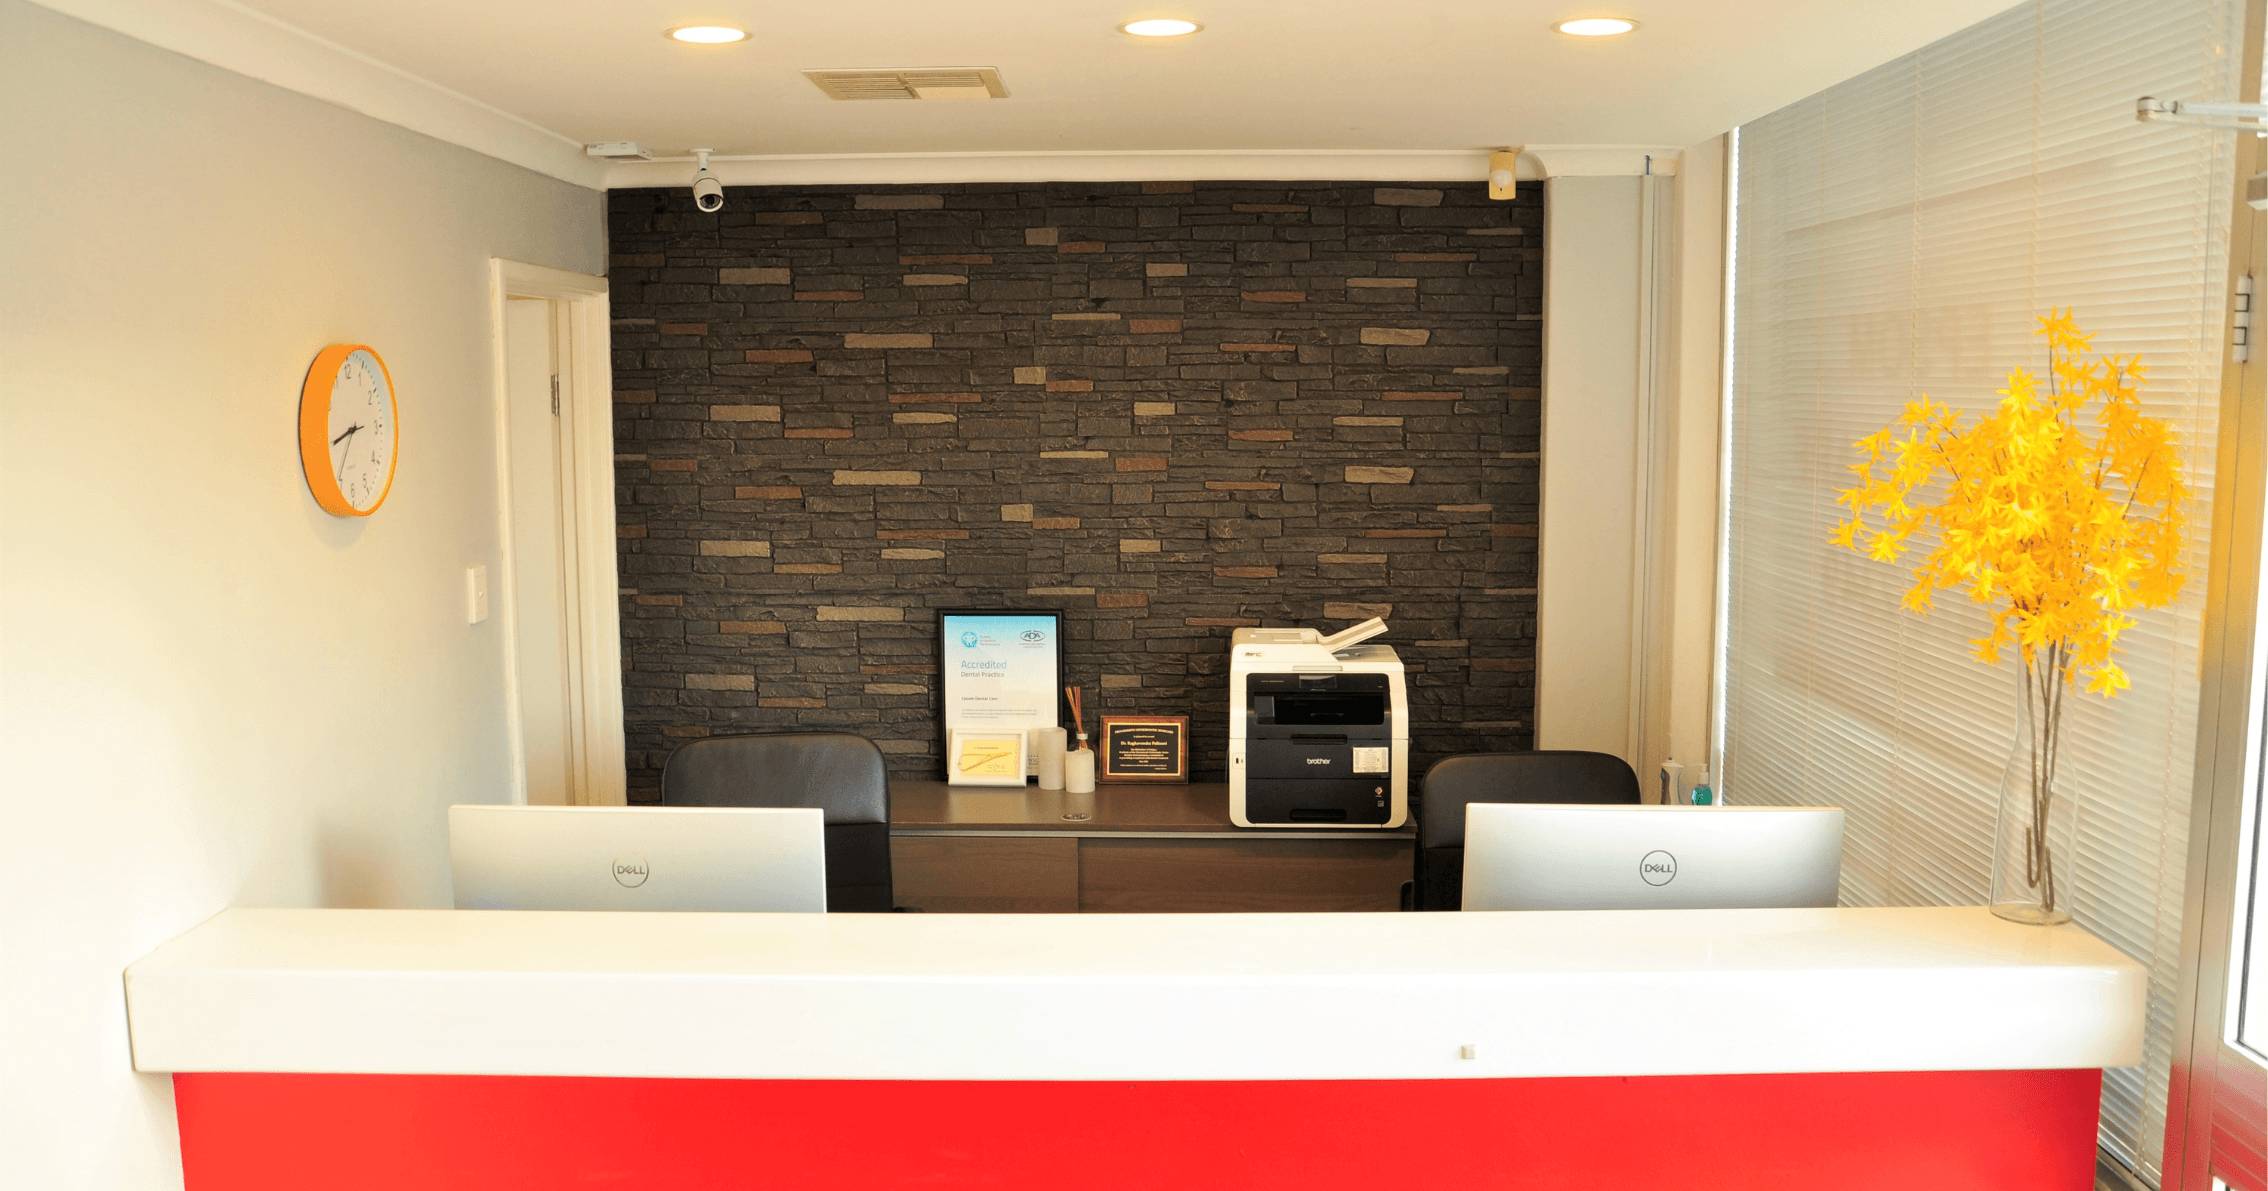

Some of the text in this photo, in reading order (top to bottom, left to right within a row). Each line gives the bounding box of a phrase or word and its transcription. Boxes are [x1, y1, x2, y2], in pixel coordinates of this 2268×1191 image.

[344, 363, 351, 380] 12
[358, 371, 362, 387] 1
[367, 390, 373, 406] 2
[373, 419, 379, 435] 3
[371, 450, 376, 465] 4
[362, 472, 368, 489] 5
[350, 482, 356, 499] 6
[1023, 632, 1042, 640] ADA
[961, 660, 1007, 669] Accredited
[961, 670, 981, 678] Dental
[617, 865, 645, 875] DELL
[1644, 863, 1673, 873] DELL
